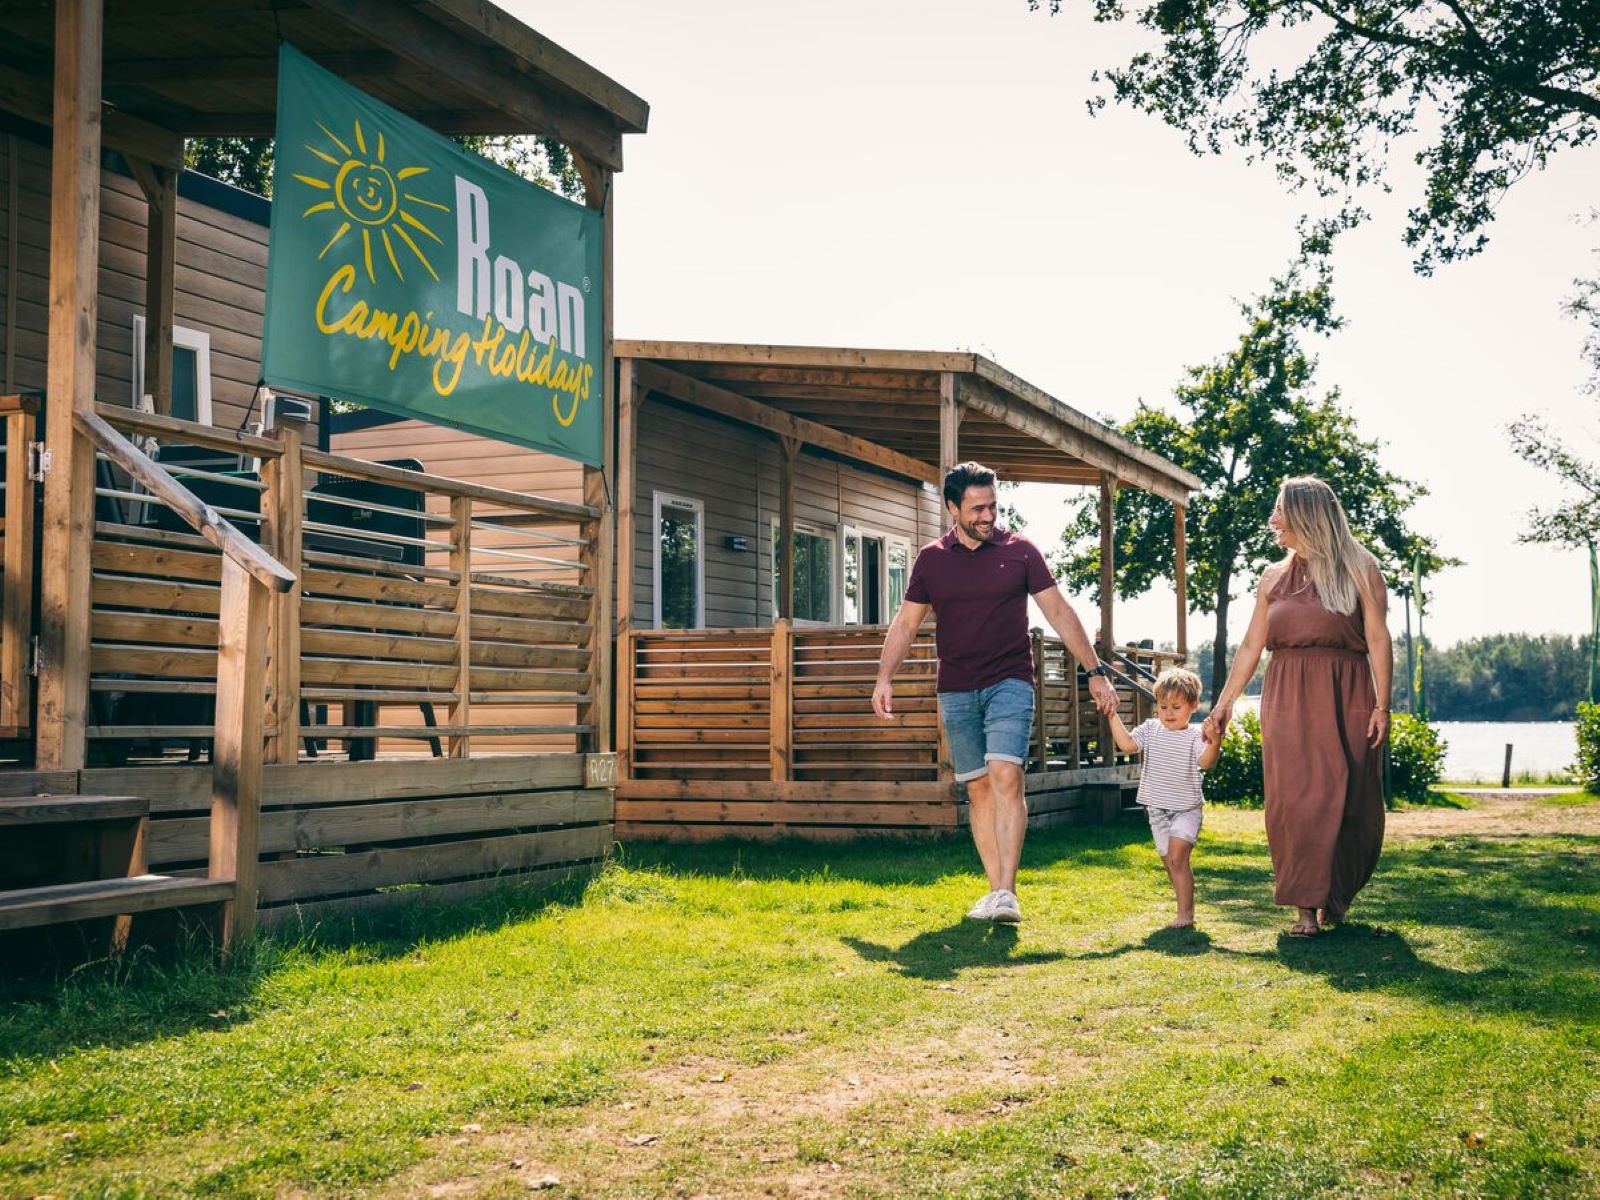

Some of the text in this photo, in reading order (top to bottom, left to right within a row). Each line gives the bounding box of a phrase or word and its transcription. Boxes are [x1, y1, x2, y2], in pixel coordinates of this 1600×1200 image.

[316, 264, 593, 427] Camping Holidays
[454, 175, 586, 360] Roan
